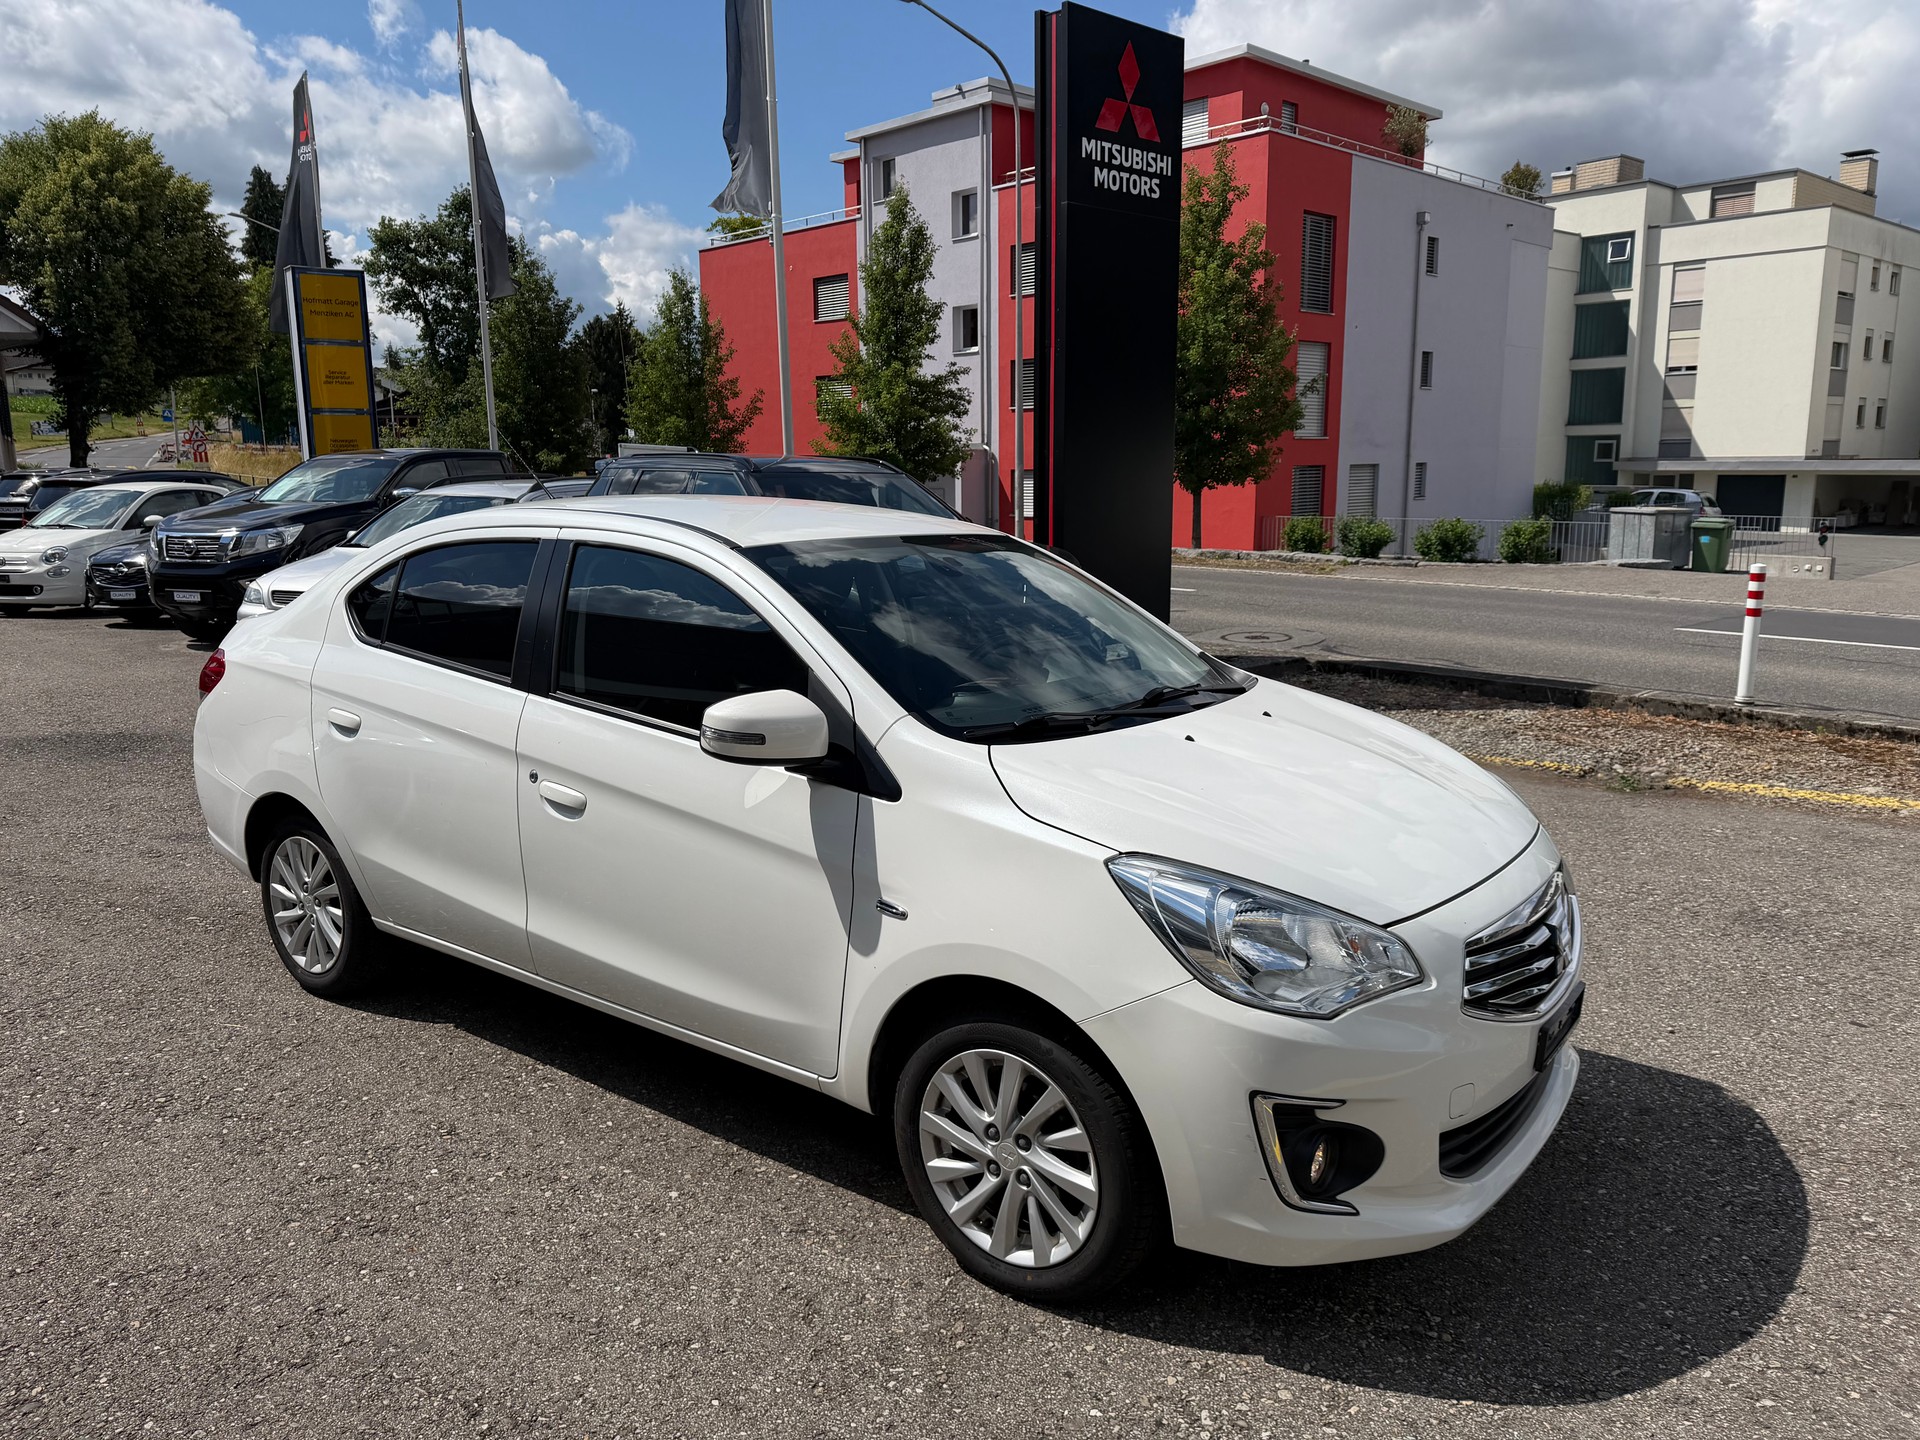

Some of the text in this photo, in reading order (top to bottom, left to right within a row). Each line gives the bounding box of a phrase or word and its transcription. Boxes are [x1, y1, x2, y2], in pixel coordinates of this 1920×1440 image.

[1081, 136, 1172, 177] MITSUBISHI
[1093, 166, 1160, 199] MOTORS
[302, 297, 359, 307] Hofmatt Garage
[309, 309, 343, 318] Menziken
